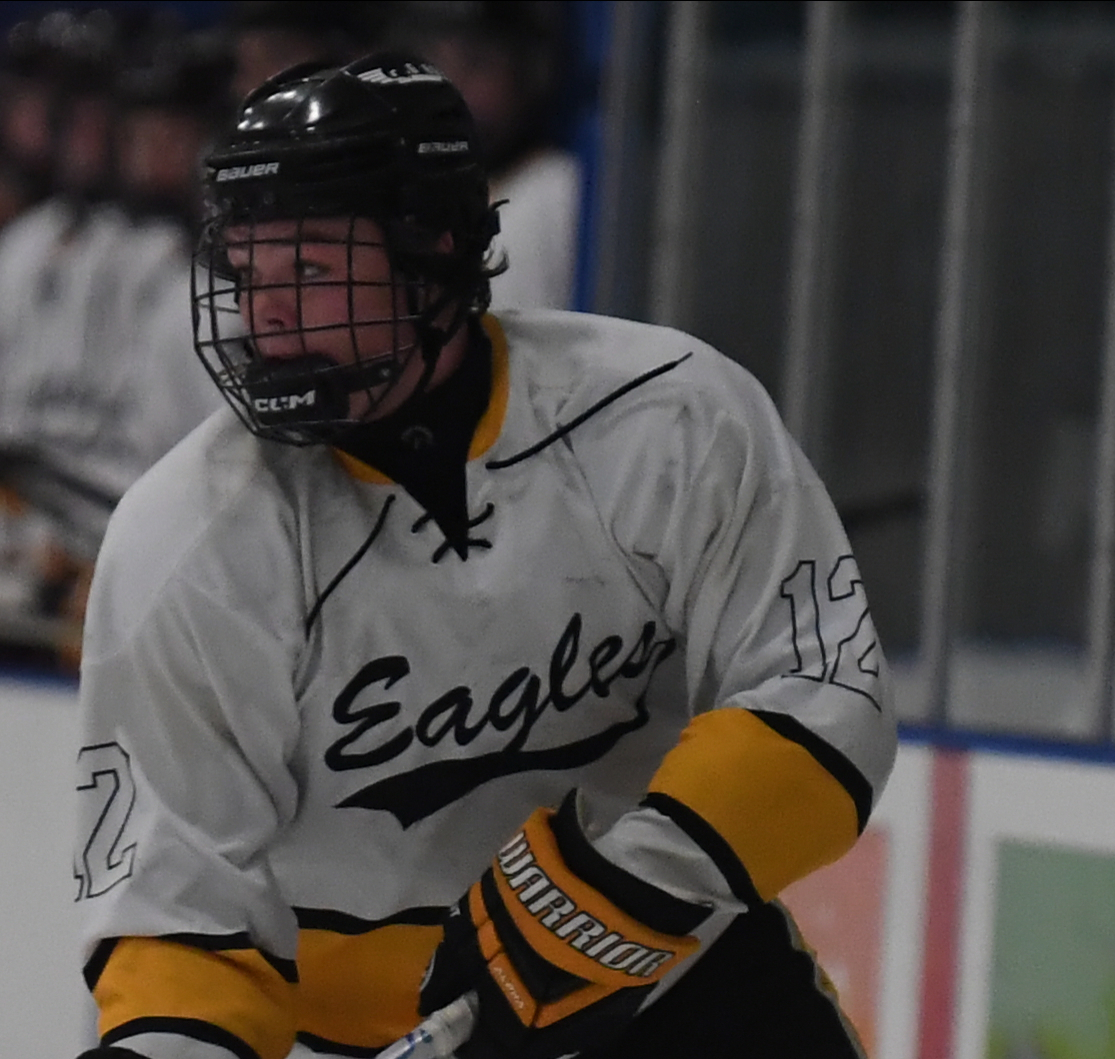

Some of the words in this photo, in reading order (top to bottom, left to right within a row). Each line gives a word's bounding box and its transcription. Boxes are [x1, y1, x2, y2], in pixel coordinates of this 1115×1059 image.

[216, 161, 280, 182] BAUER
[324, 612, 677, 772] Eagles
[780, 555, 882, 712] 12
[496, 830, 675, 978] WARRIOR
